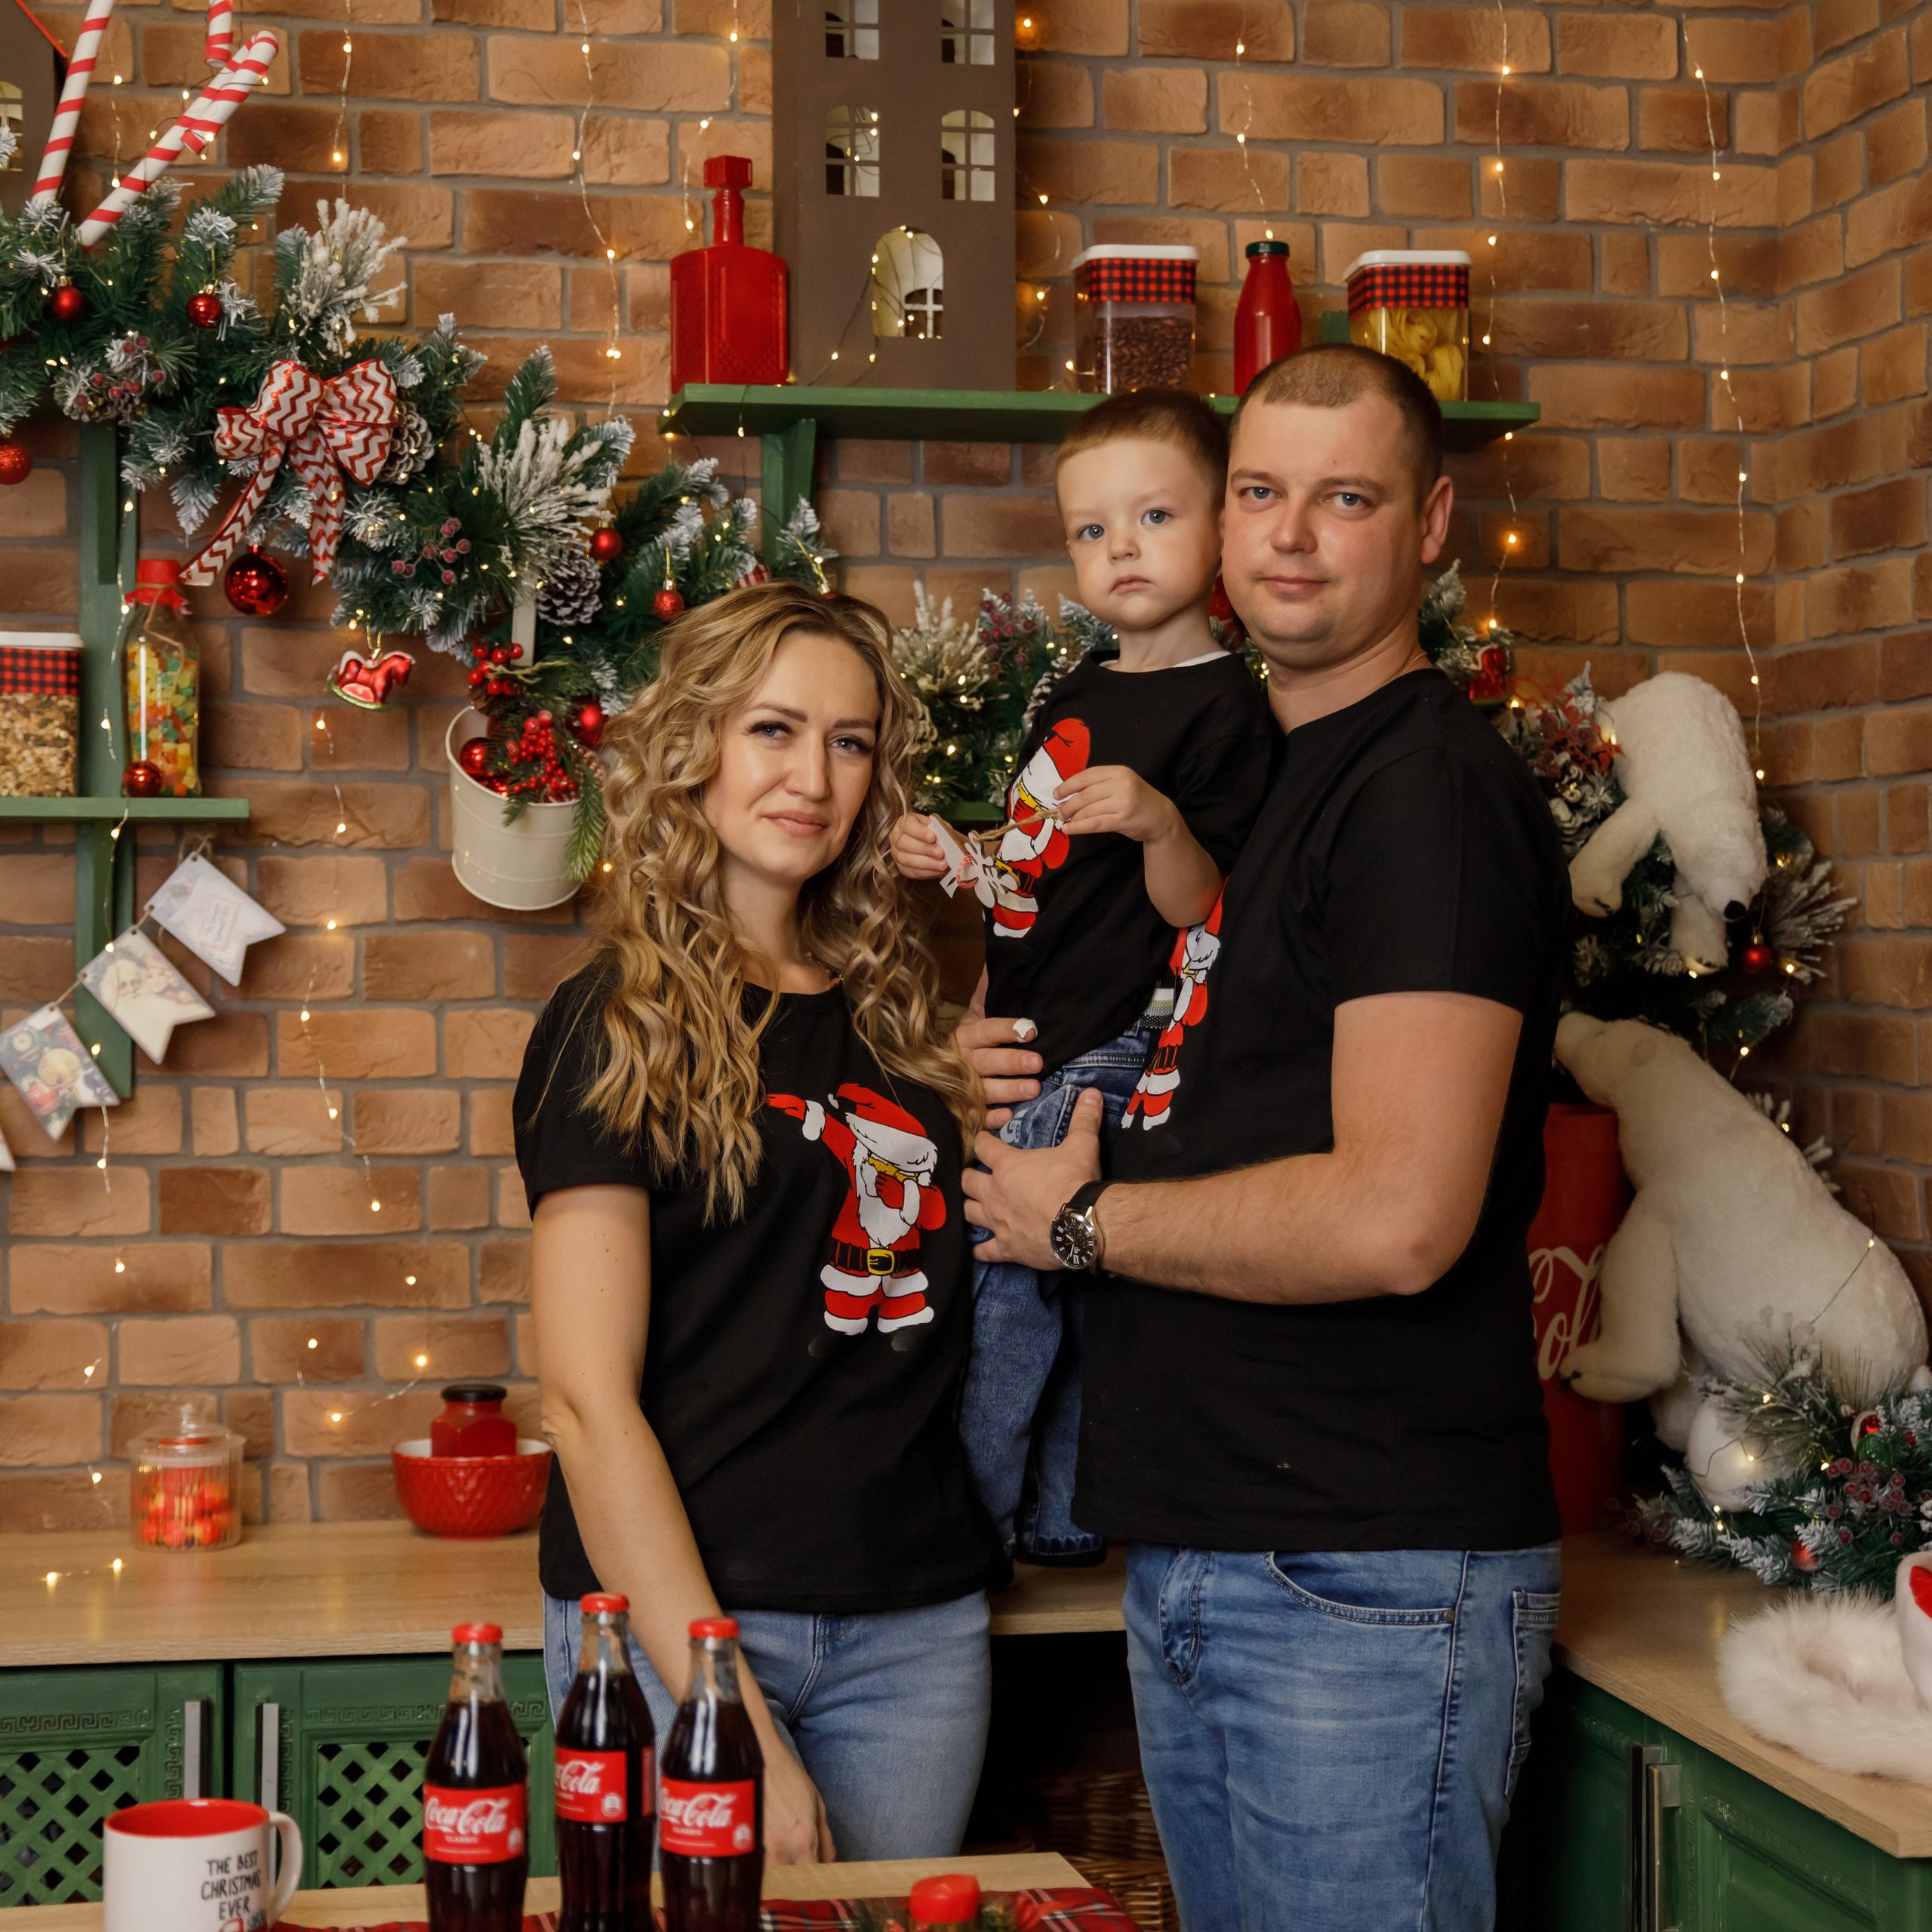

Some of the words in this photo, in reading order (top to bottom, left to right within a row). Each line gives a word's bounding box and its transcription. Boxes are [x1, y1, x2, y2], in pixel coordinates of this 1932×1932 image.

[207, 1857, 231, 1875] THE
[238, 1850, 257, 1870] BEST
[202, 1869, 260, 1900] CHRISTMAS
[219, 1896, 250, 1920] EVER
